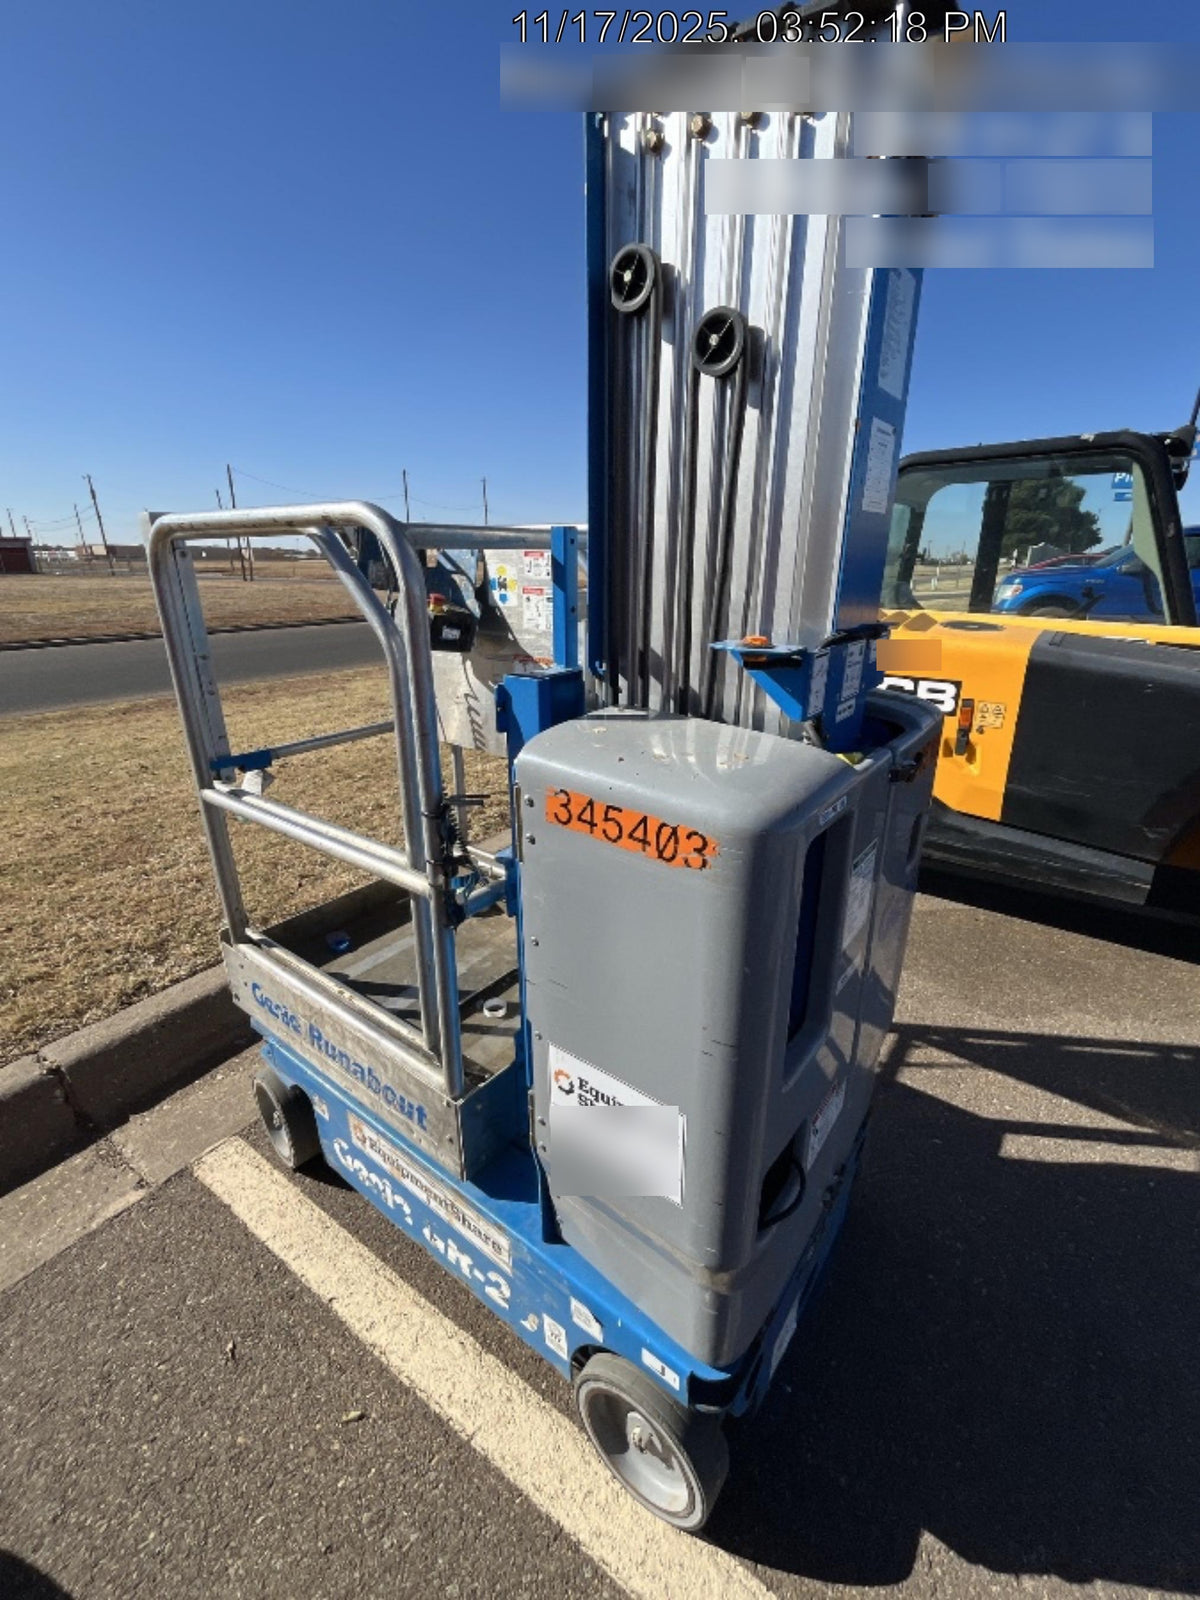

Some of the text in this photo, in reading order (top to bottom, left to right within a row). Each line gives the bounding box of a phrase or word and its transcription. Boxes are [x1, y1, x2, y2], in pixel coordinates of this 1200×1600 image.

[553, 788, 709, 871] 345403
[308, 1022, 428, 1132] Runabout
[577, 1076, 624, 1106] Equi
